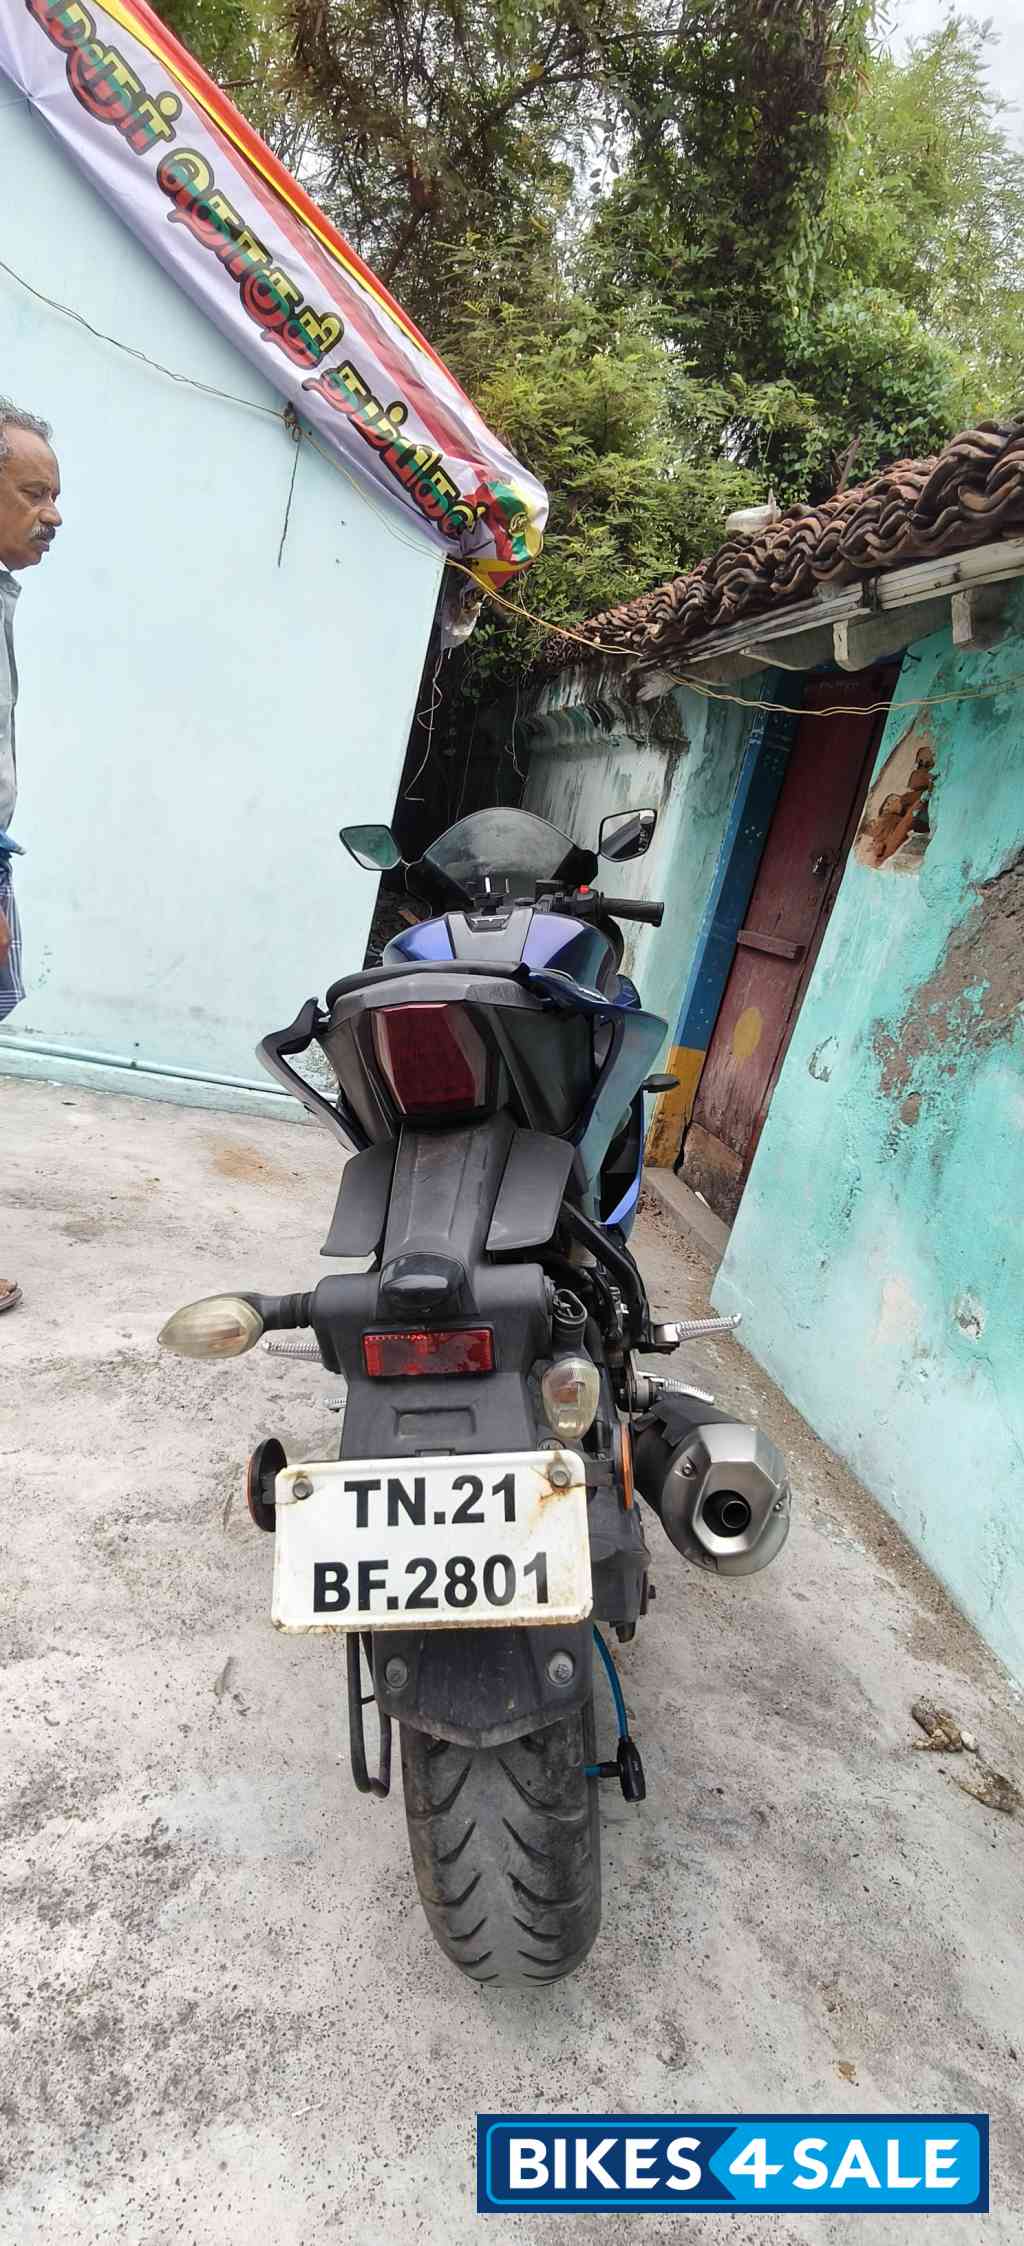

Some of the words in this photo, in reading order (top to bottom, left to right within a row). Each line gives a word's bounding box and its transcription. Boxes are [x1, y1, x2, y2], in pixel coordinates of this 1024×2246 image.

[157, 148, 345, 370] தொகுதி
[344, 1473, 516, 1528] TN.21
[313, 1551, 549, 1612] BF.2801
